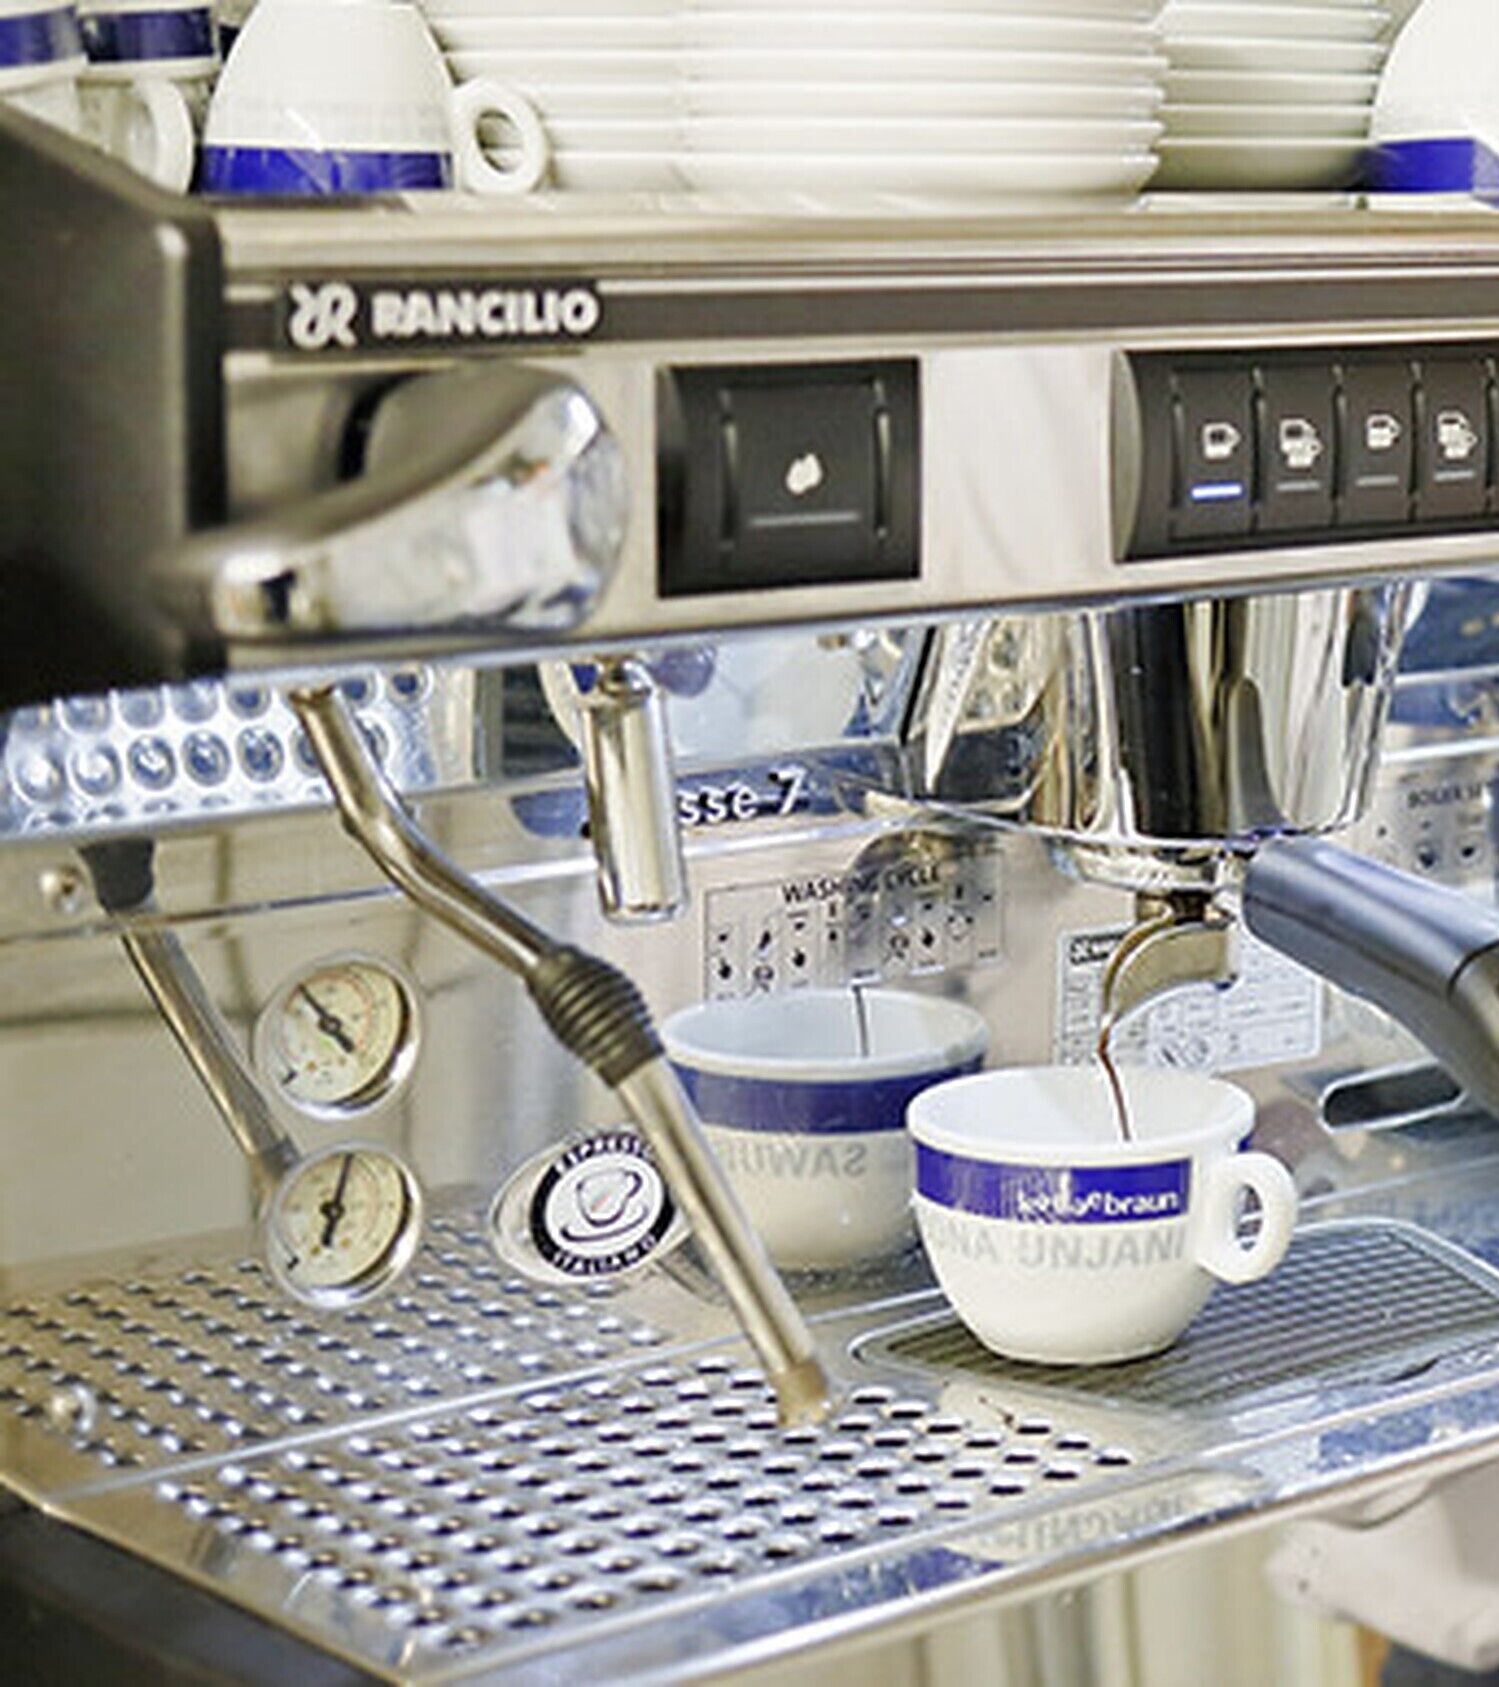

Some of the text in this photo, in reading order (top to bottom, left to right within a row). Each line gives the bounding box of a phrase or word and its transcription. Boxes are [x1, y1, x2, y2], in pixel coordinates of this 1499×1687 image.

[371, 289, 599, 338] RANCILIO
[677, 765, 807, 826] sse 7
[1016, 1225, 1188, 1270] UNJANI
